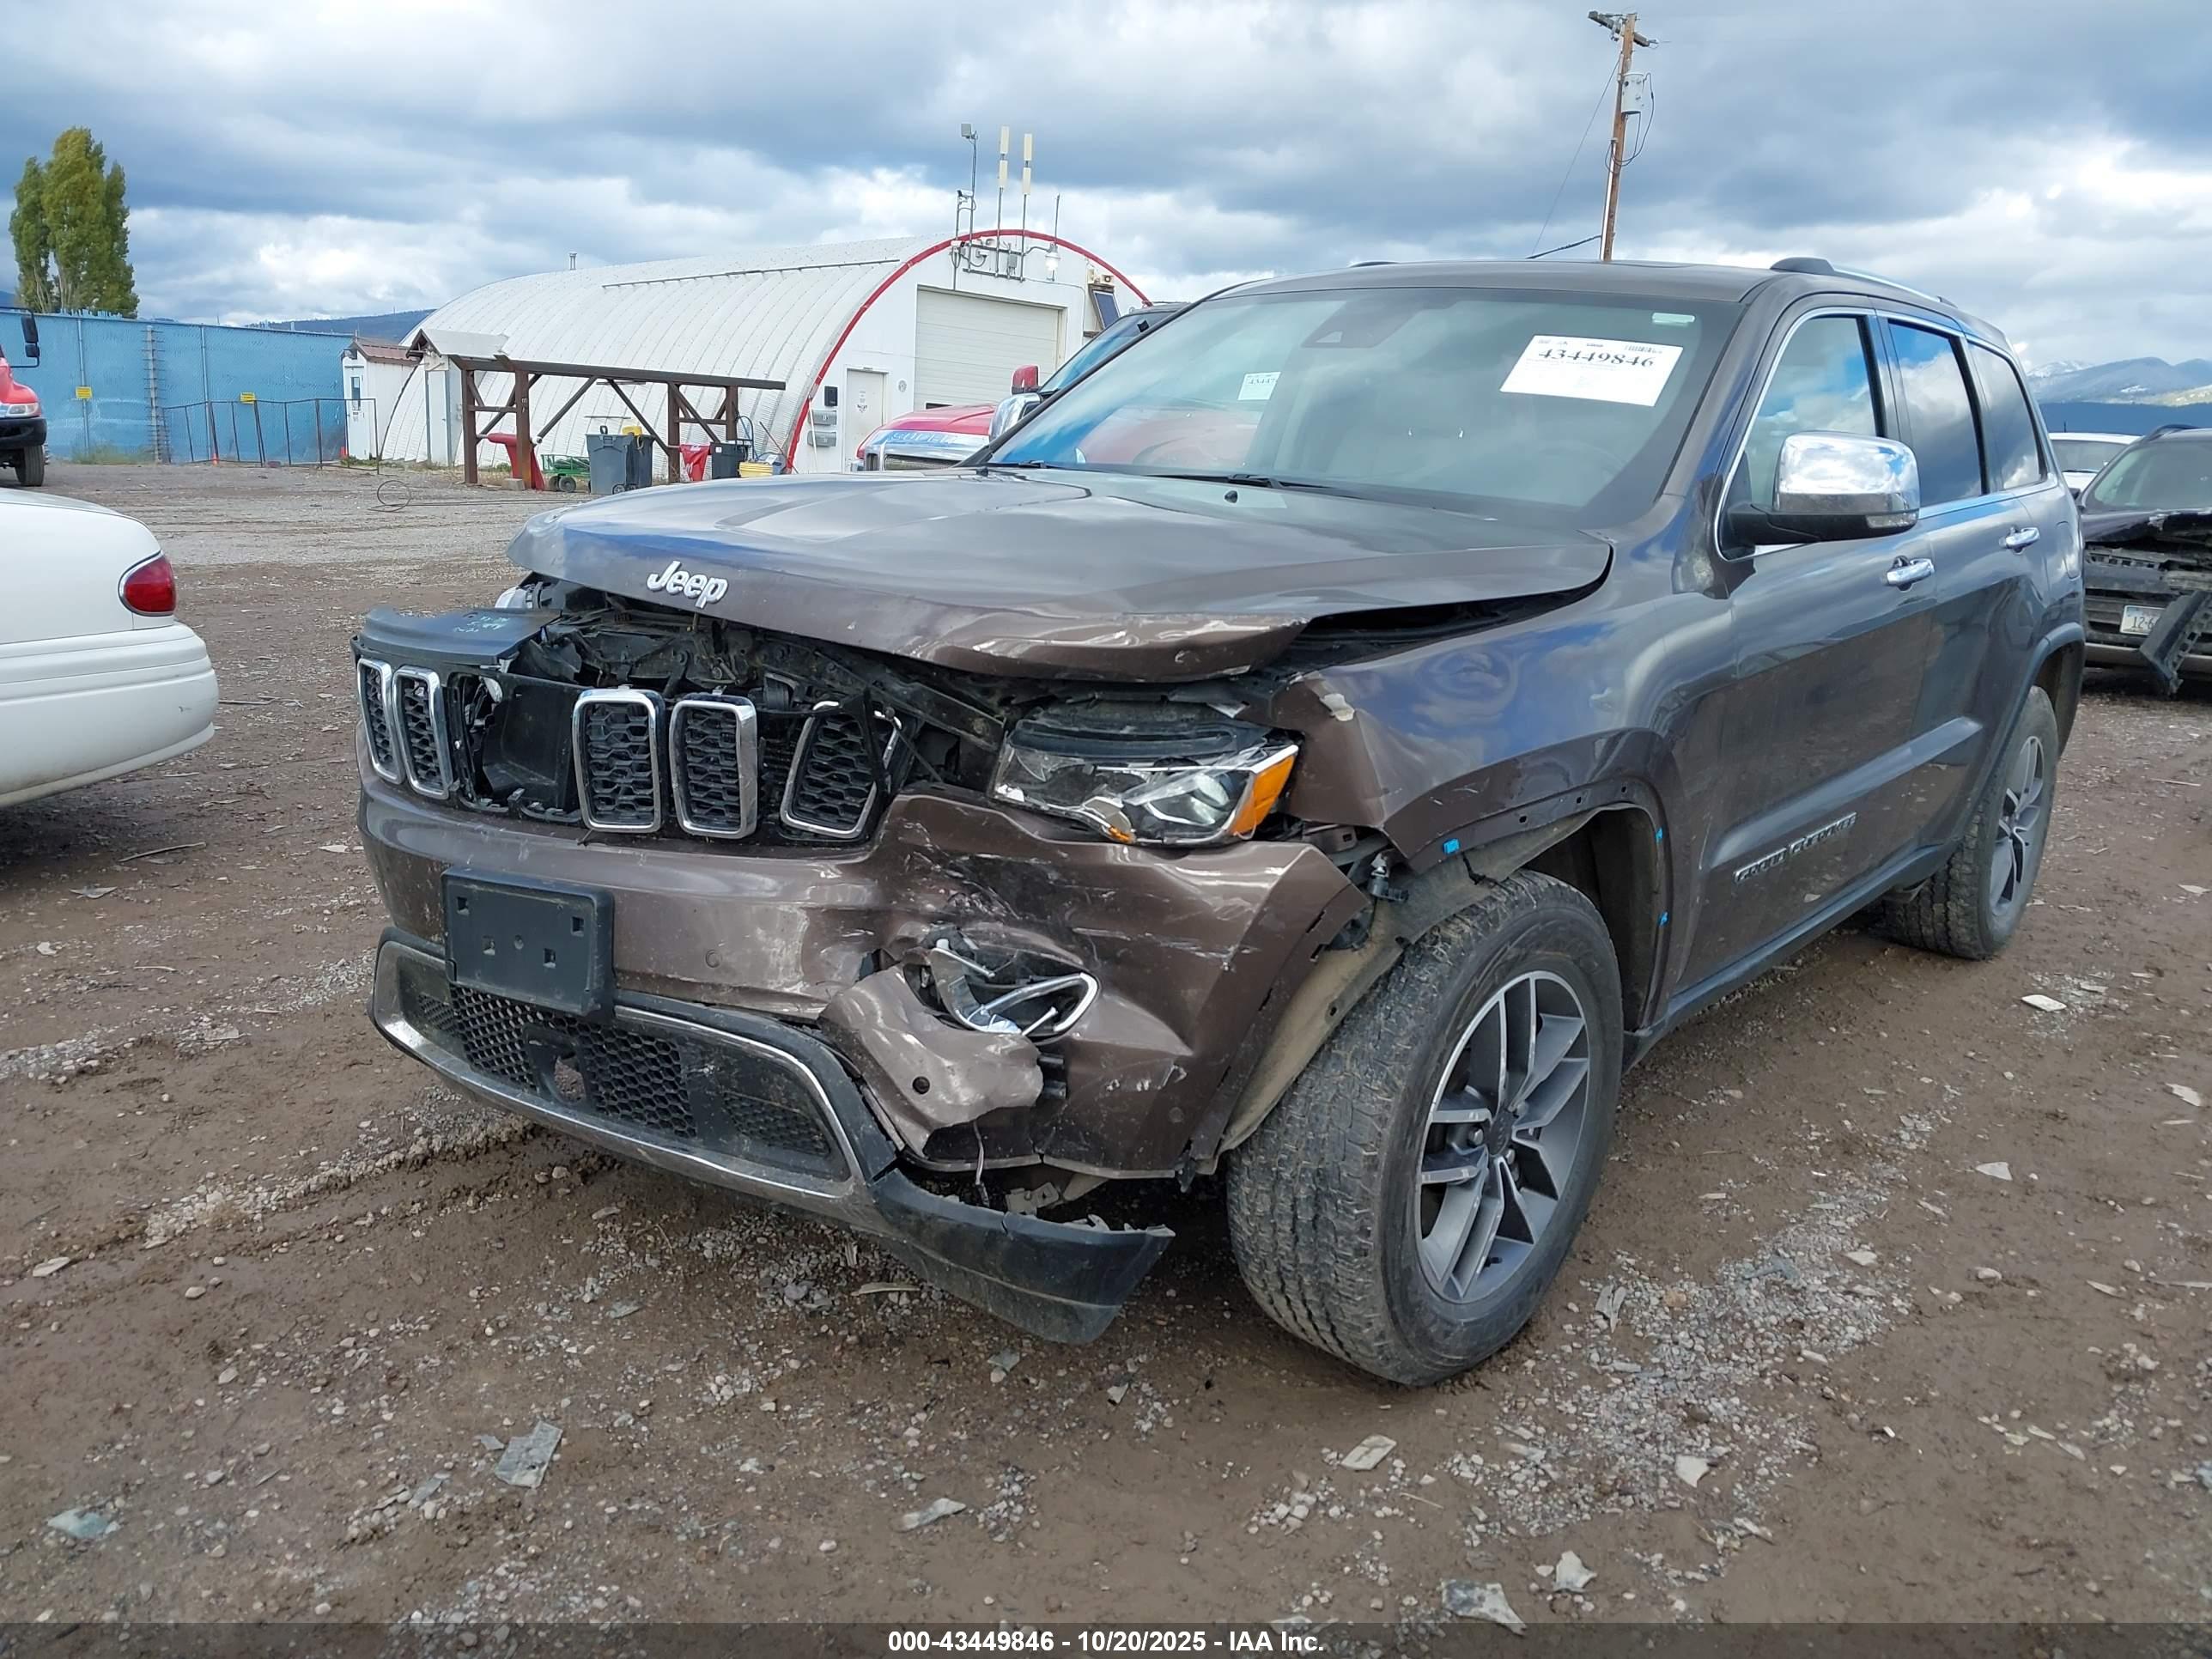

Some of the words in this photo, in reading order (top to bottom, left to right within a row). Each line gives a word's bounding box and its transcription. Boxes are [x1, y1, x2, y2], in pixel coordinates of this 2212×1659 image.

[1538, 348, 1656, 368] 43449846
[647, 560, 728, 609] Jeep
[1734, 847, 1787, 884] GRAND
